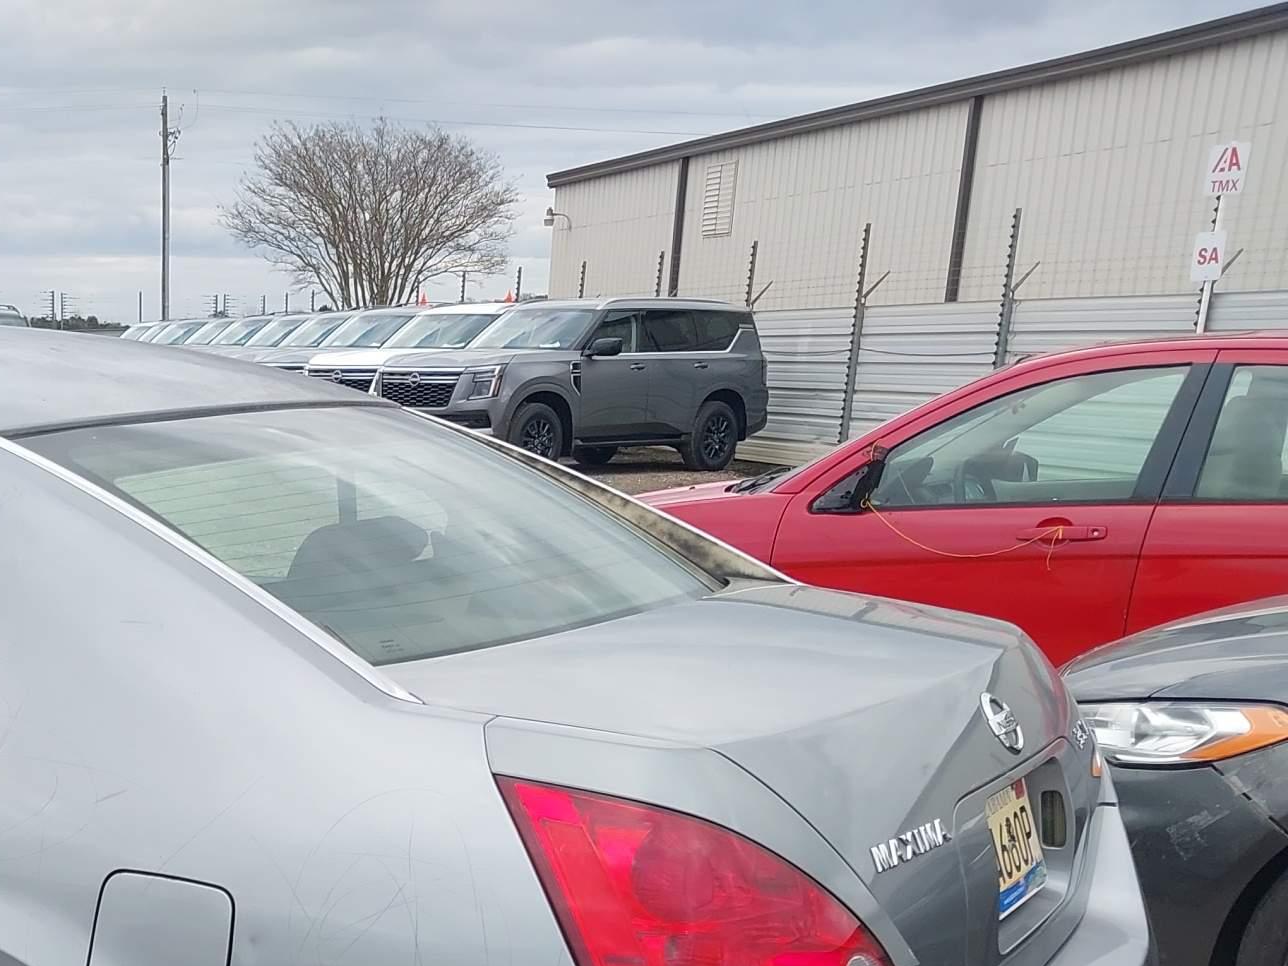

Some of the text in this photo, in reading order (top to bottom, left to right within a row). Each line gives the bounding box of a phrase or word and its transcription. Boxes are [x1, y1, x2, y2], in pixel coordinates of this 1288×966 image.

[1211, 178, 1240, 193] TMX
[1197, 246, 1219, 266] SA
[869, 818, 953, 873] MAXIMA
